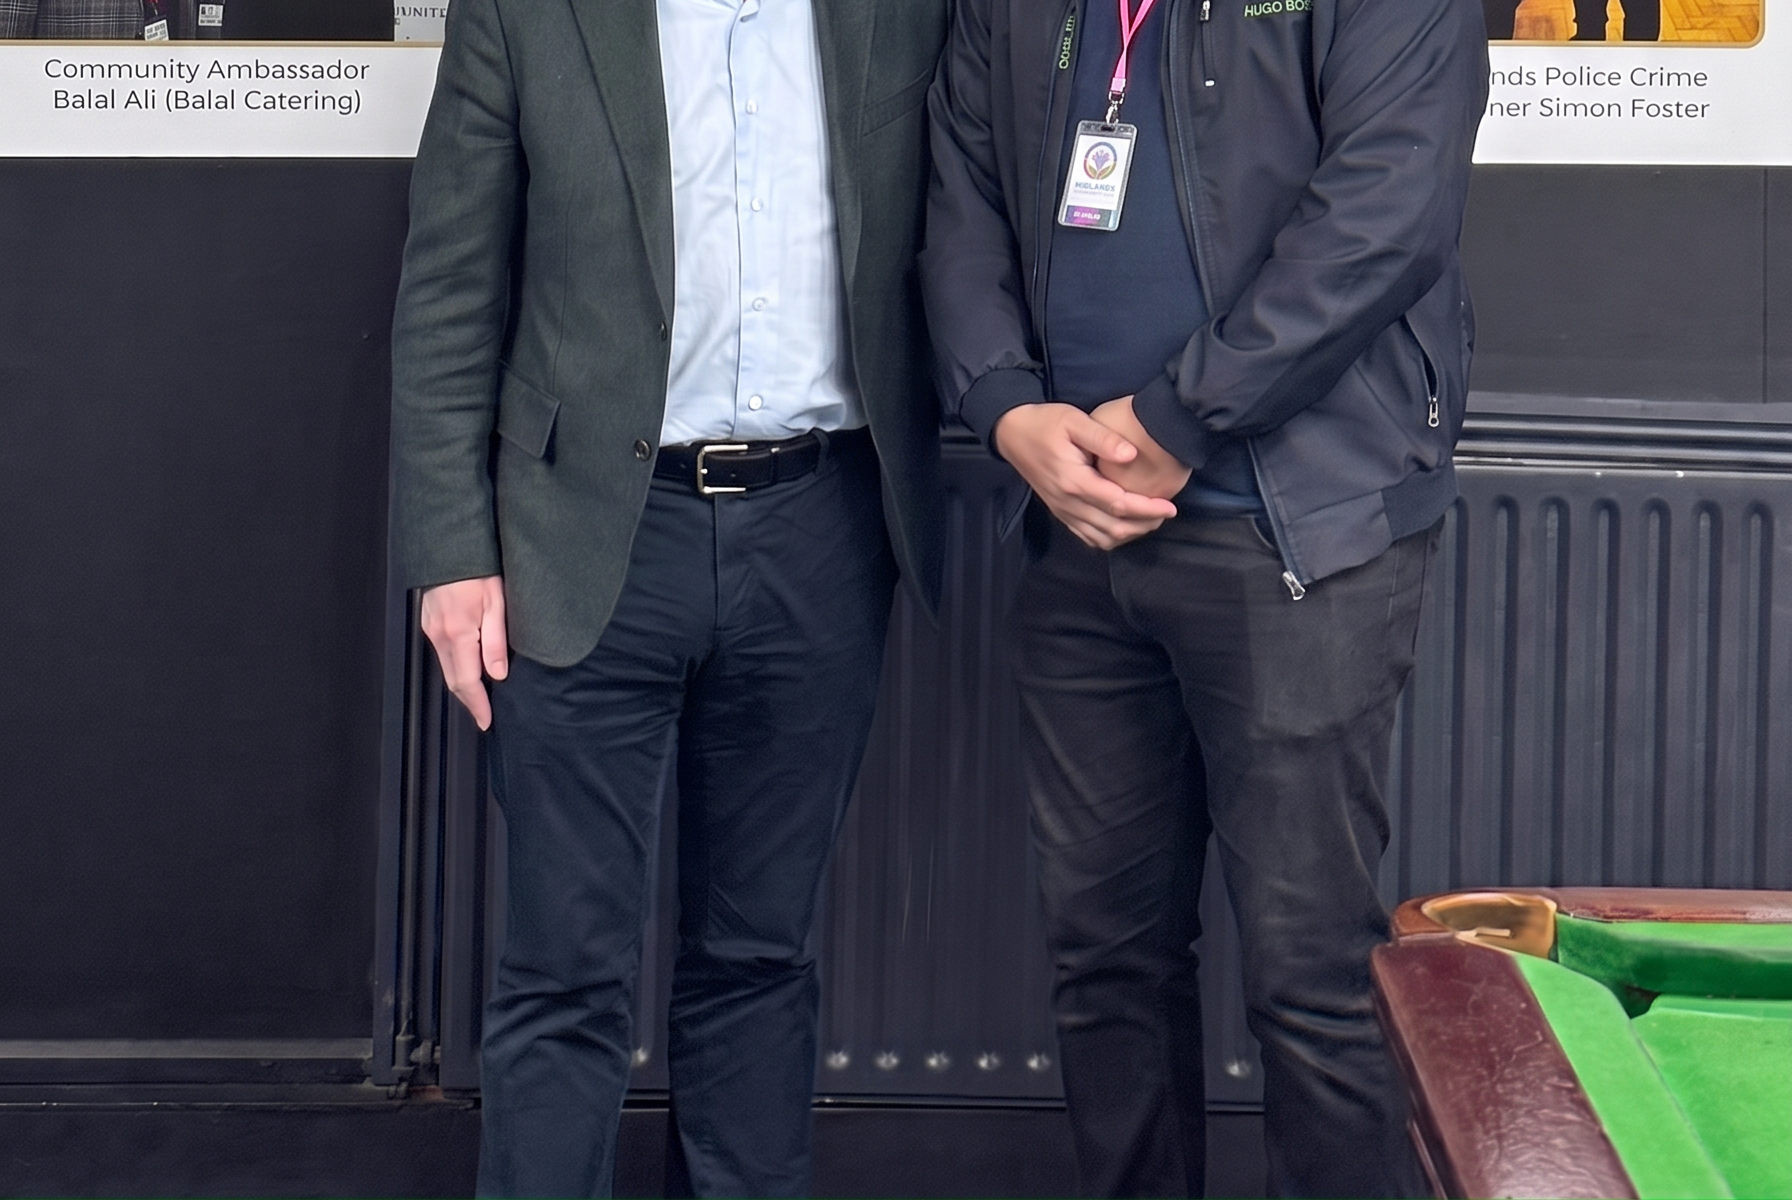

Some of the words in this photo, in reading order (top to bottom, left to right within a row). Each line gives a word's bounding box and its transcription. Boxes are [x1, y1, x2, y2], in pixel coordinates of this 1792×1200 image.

[1244, 1, 1283, 18] HUGO
[44, 58, 200, 84] Community
[206, 58, 370, 80] Ambassador
[1489, 65, 1537, 86] nds
[1546, 65, 1622, 86] Police
[1630, 66, 1708, 87] Crime
[54, 88, 115, 110] Balal
[123, 88, 156, 110] Ali
[165, 88, 235, 113] (Balal
[244, 89, 361, 116] Catering)
[1490, 102, 1532, 117] ner
[1539, 97, 1622, 118] Simon
[1631, 98, 1710, 118] Foster
